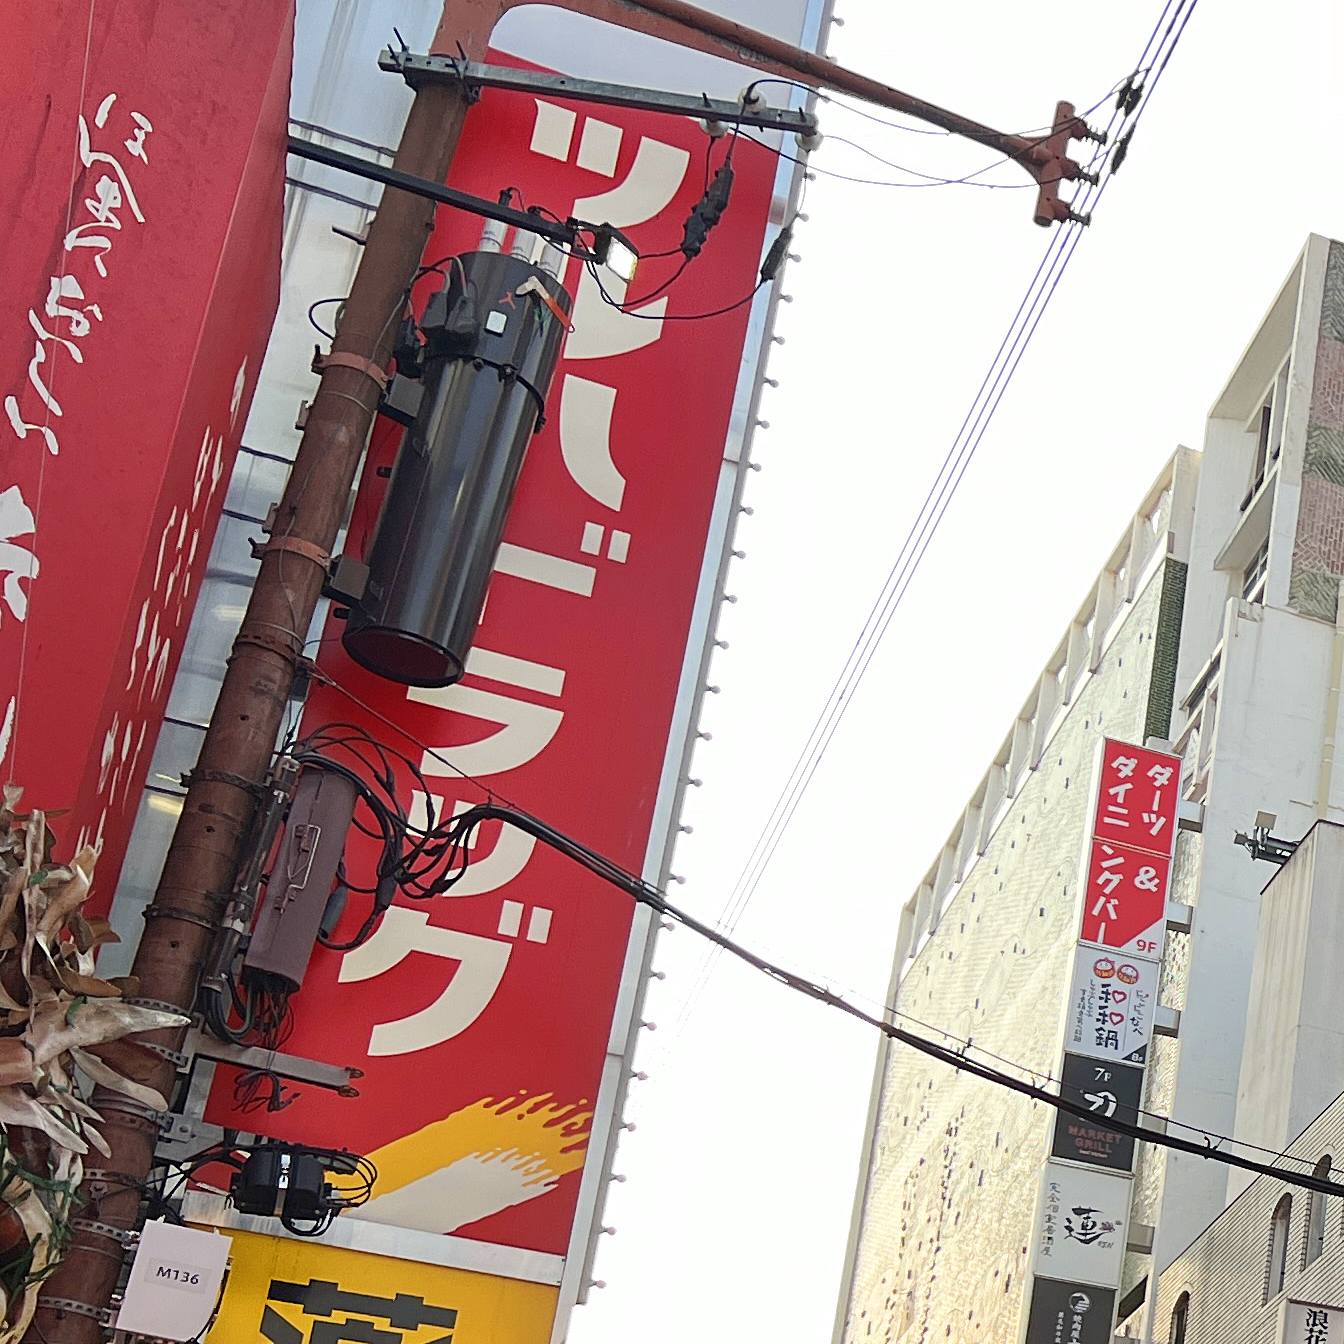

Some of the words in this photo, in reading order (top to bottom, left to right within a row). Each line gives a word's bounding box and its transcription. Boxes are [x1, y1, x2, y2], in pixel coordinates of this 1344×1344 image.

[1092, 754, 1139, 943] ダイニングバー
[1136, 939, 1158, 954] 9F
[155, 1264, 201, 1287] M136
